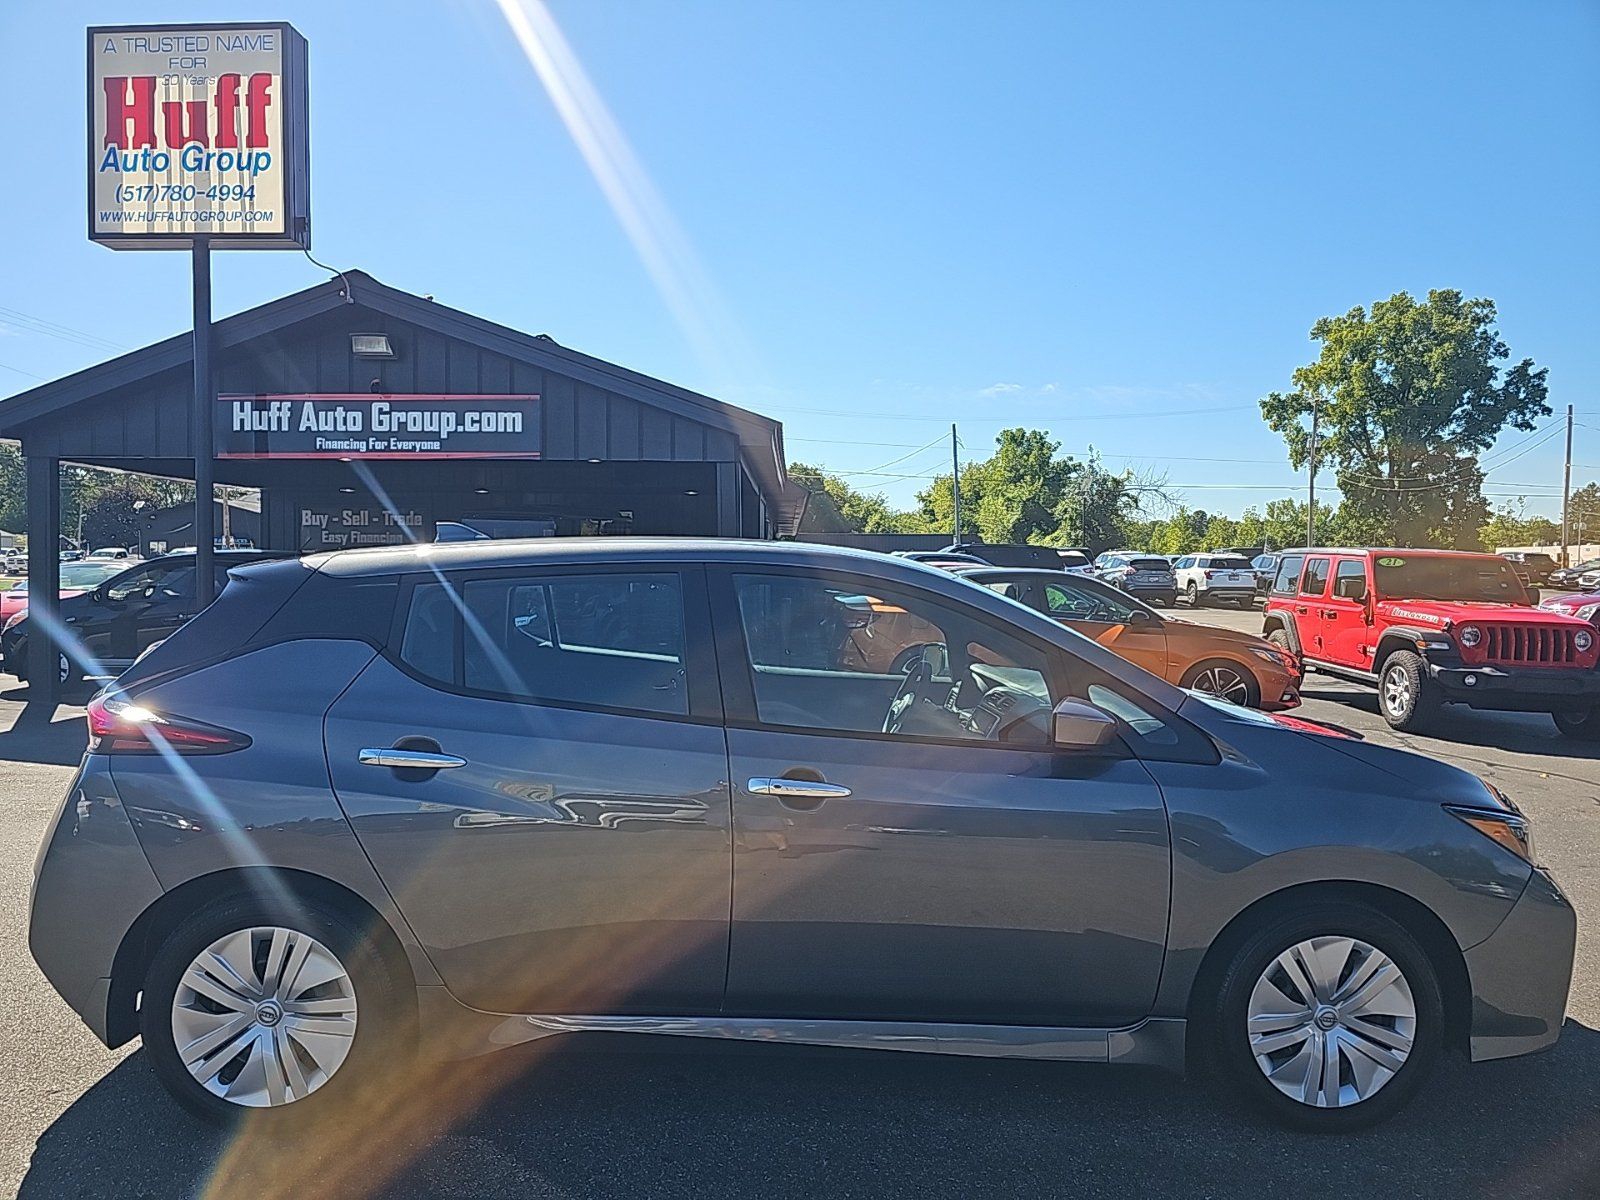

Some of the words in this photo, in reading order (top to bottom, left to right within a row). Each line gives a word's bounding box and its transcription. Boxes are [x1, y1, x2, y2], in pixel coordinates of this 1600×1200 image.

[103, 38, 117, 54] A
[123, 35, 210, 53] TRUSTED
[216, 34, 274, 51] NAME
[168, 57, 207, 69] FOR
[183, 74, 216, 86] Years
[103, 73, 273, 150] Huff
[99, 146, 170, 173] Auto
[181, 145, 272, 177] Group
[115, 184, 256, 203] (517)780-4994
[99, 210, 274, 222] WWW.HUFFAUTOGROUP.COM
[232, 401, 292, 432] Huff
[299, 401, 363, 432] Auto
[371, 401, 523, 439] Group.com
[316, 438, 367, 452] Financing
[368, 438, 388, 451] For
[390, 438, 441, 452] Everyone
[301, 510, 328, 529] Buy
[342, 510, 369, 526] Sell
[382, 510, 423, 526] Trade
[321, 530, 348, 546] Easy
